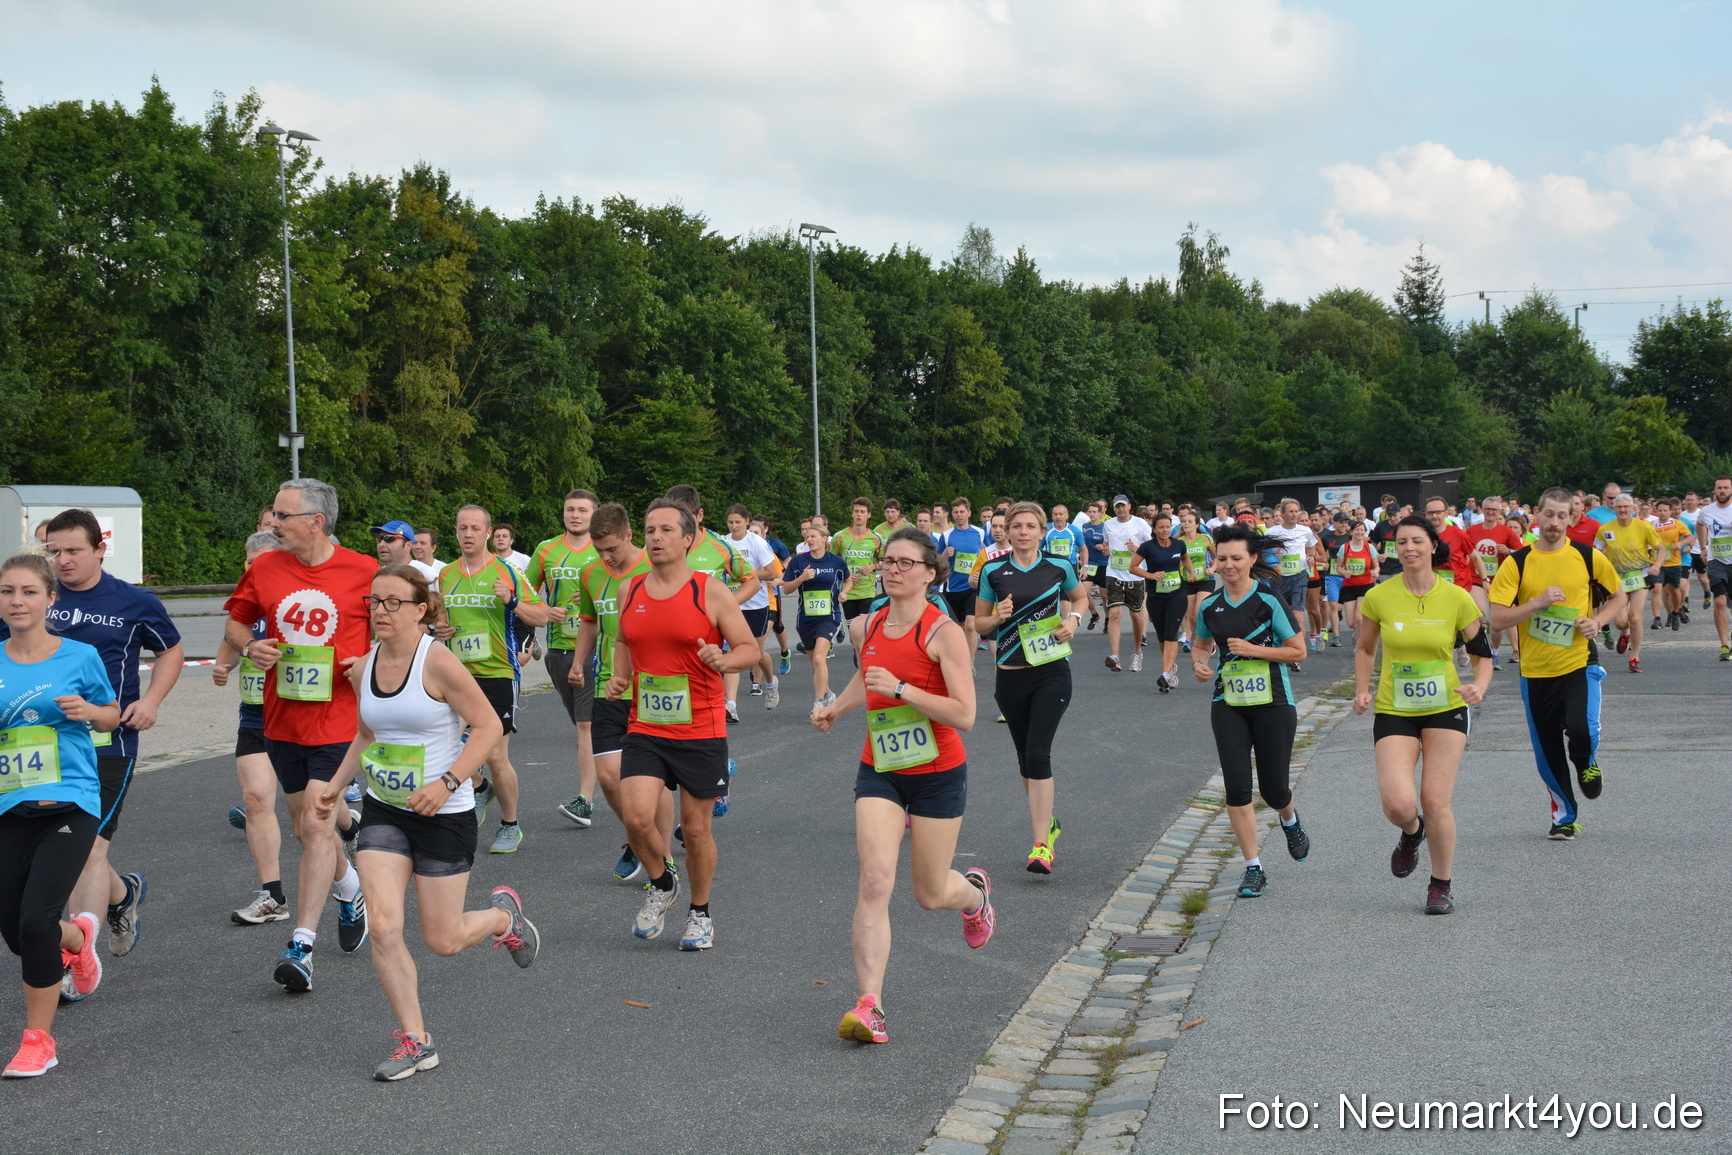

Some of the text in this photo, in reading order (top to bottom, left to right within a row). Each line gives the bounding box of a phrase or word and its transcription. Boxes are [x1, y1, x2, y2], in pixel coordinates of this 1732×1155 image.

[1478, 544, 1495, 556] 48
[1712, 544, 1731, 552] 1580
[959, 560, 973, 569] 794
[1625, 577, 1639, 586] 481
[443, 593, 497, 609] BOCK
[809, 600, 826, 609] 376
[83, 613, 125, 628] POLES
[283, 602, 329, 637] 48
[1534, 617, 1573, 636] 1277
[457, 637, 481, 652] 141
[243, 676, 265, 691] 375
[286, 666, 319, 685] 512
[1228, 677, 1266, 693] 1348
[1404, 681, 1437, 697] 650
[10, 690, 34, 708] Schick
[35, 683, 52, 692] Bau
[642, 693, 684, 711] 1367
[877, 727, 927, 754] 1370
[0, 751, 43, 775] 814
[365, 764, 416, 792] 1554
